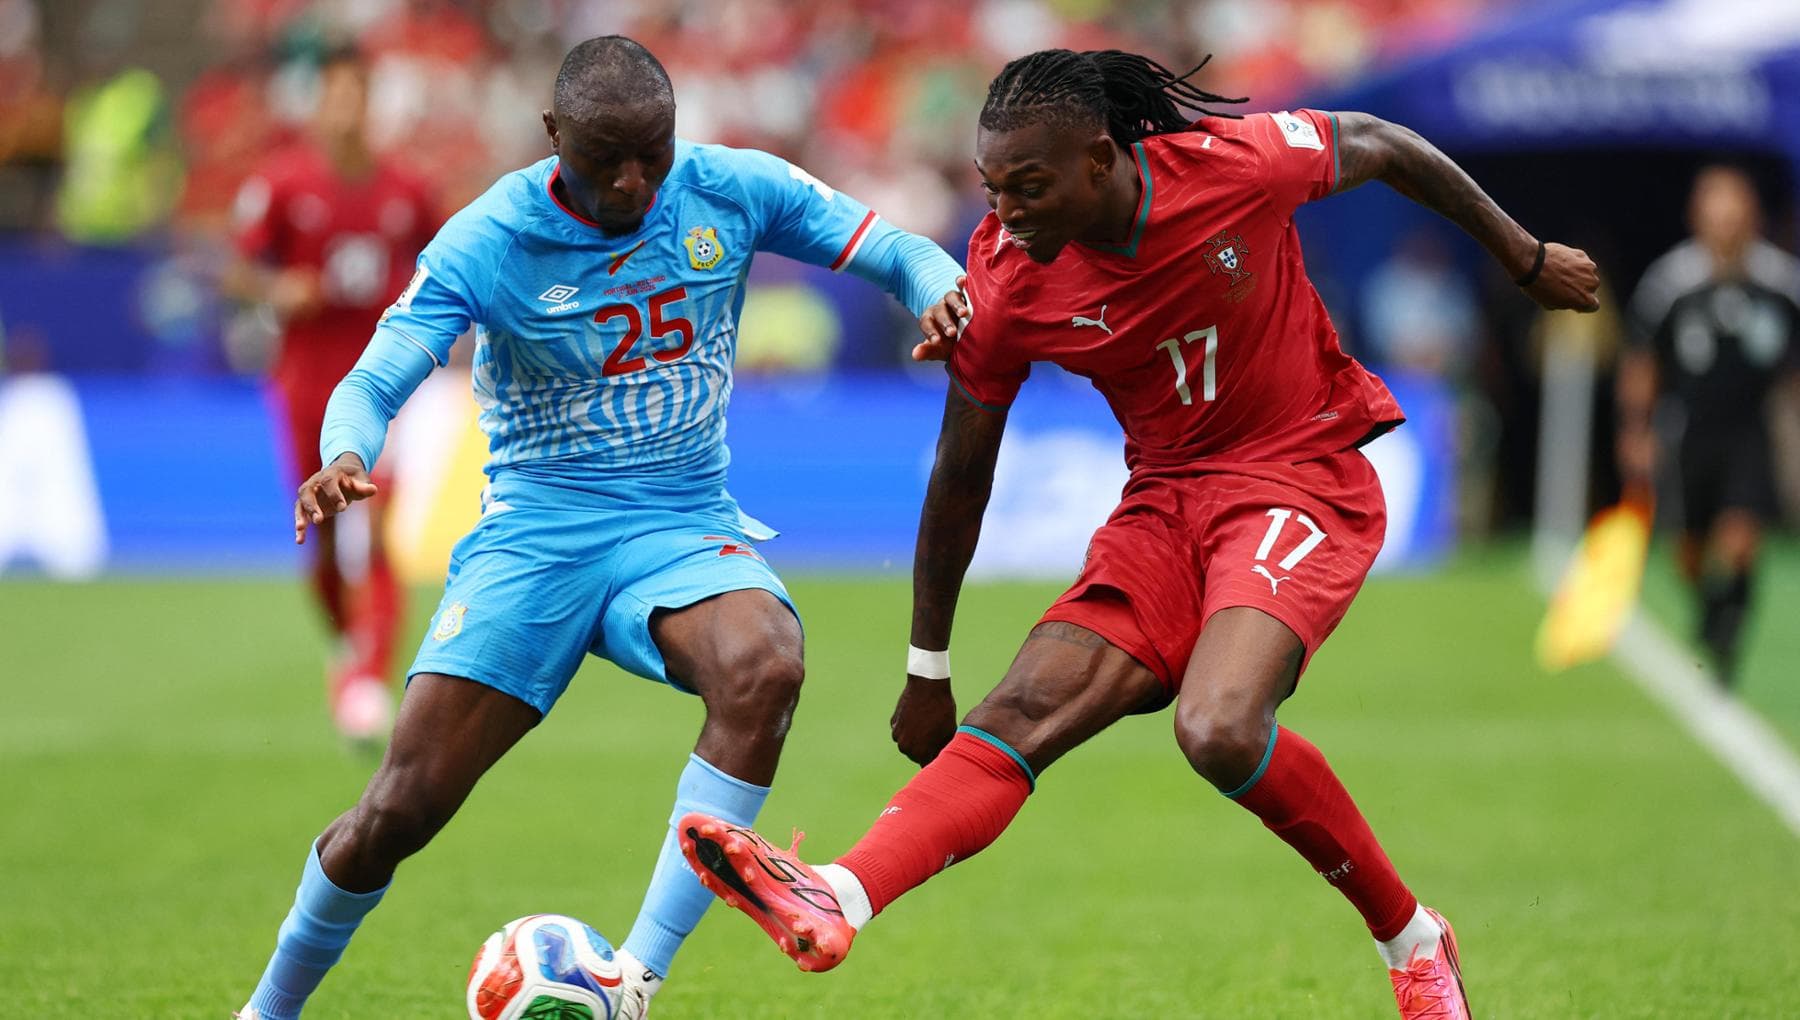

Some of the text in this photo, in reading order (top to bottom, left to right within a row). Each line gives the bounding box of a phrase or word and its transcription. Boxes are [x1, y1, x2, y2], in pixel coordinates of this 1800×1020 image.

[546, 301, 580, 314] umbro
[593, 287, 694, 378] 25
[1156, 325, 1218, 405] 17
[1254, 508, 1328, 571] 17
